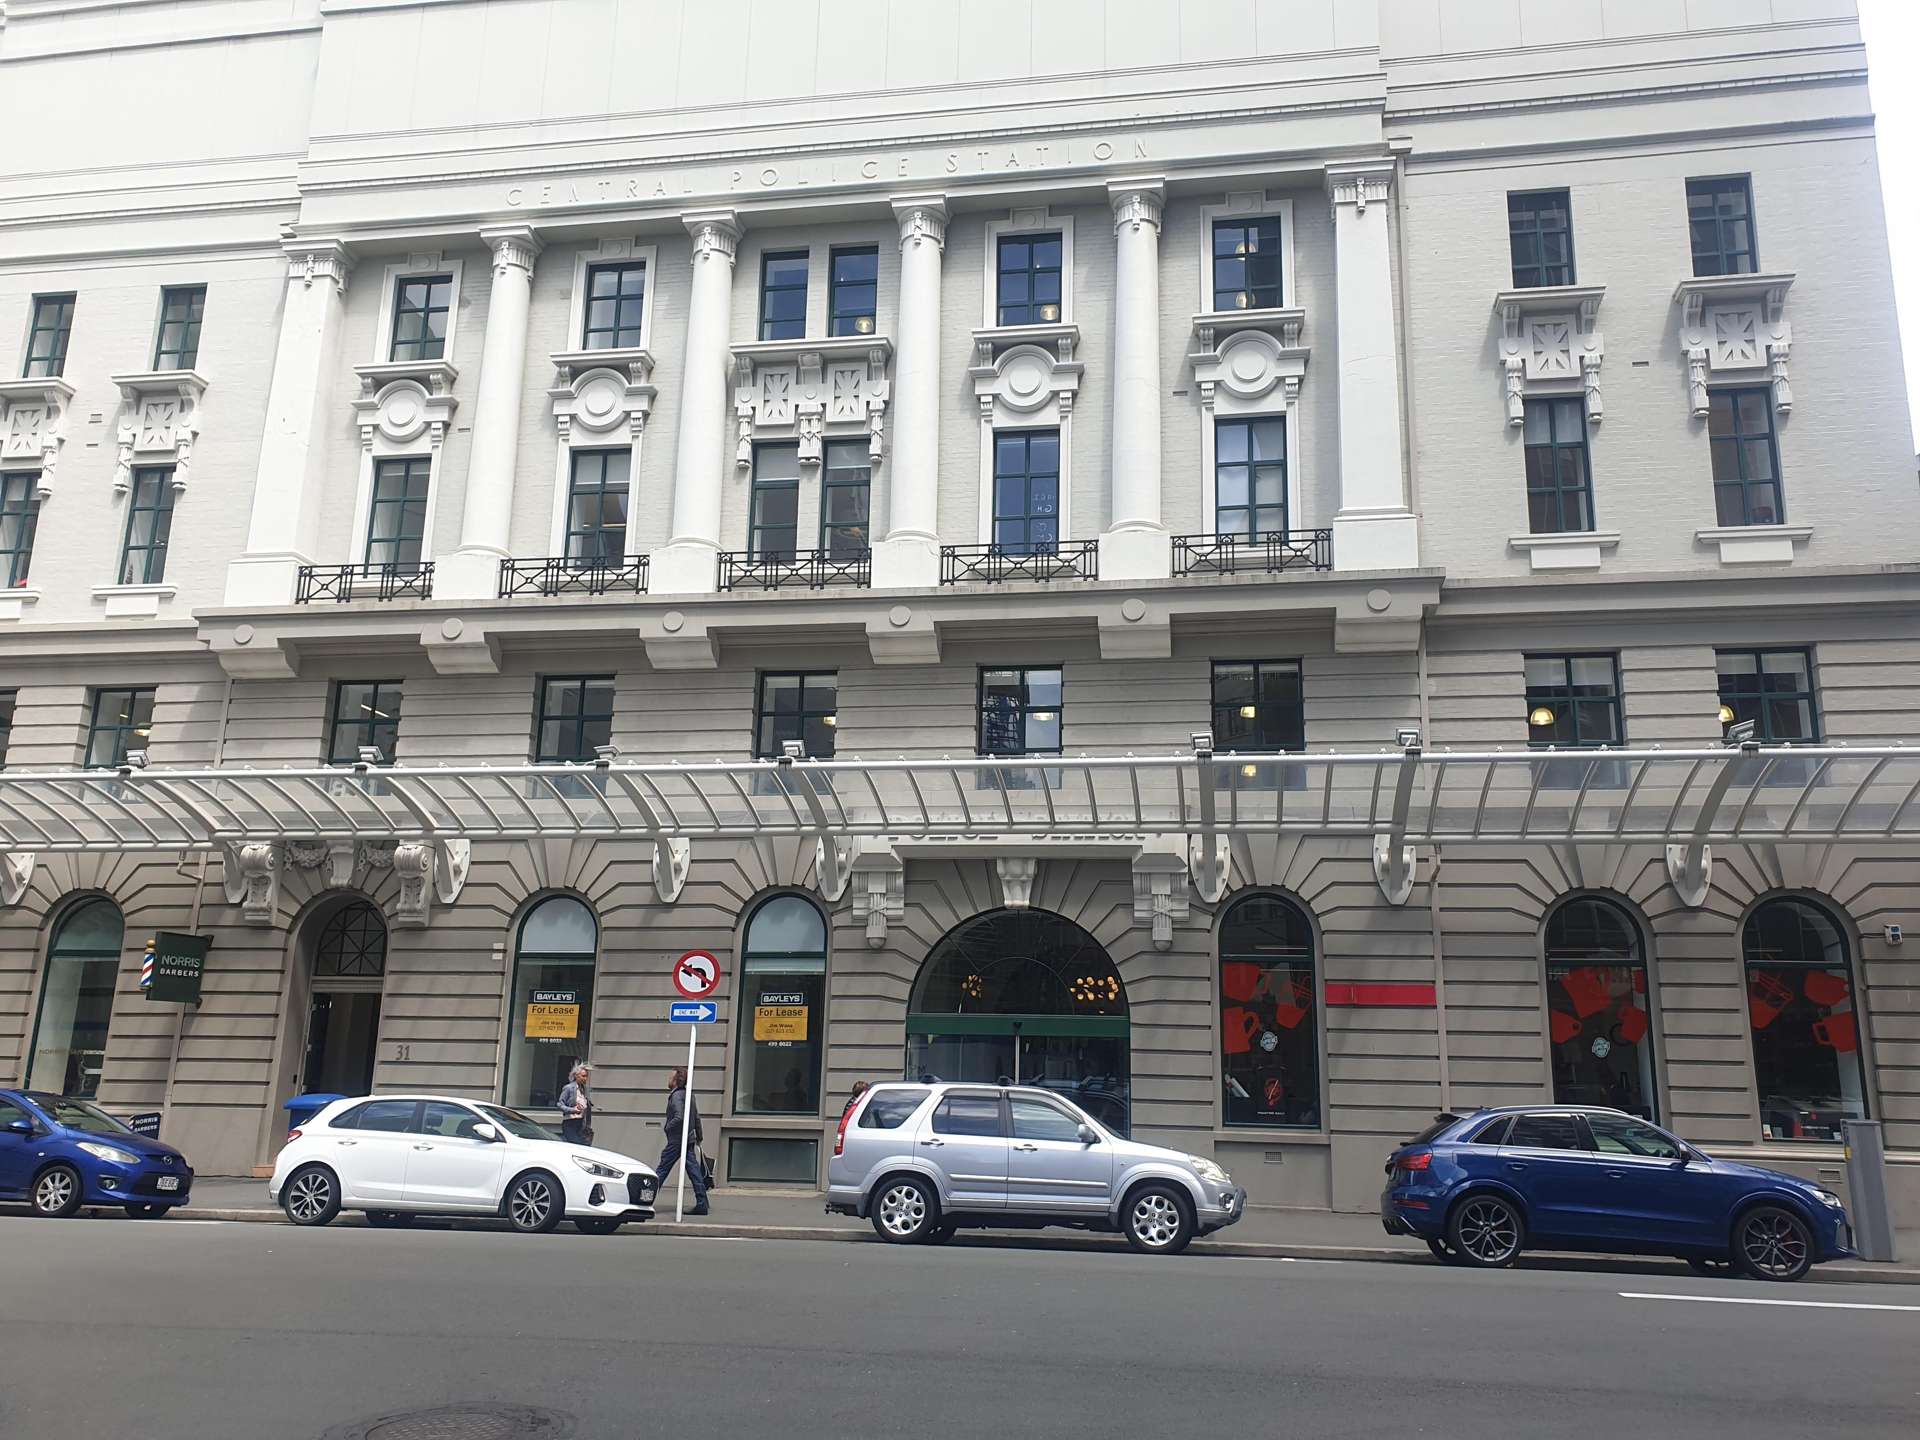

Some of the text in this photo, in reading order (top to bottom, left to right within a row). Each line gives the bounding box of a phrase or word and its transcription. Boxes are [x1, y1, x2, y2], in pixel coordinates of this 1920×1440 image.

[506, 140, 1148, 206] CENTRAL POLICE STATION
[160, 954, 201, 968] NORRIS
[159, 967, 200, 978] BARBERS
[536, 993, 572, 1001] BAYLEYS
[763, 995, 800, 1003] BAYLEYS
[532, 1005, 574, 1014] For Lease
[759, 1007, 803, 1017] For Lease
[395, 1044, 410, 1061] 31
[135, 1117, 158, 1125] NORRIS
